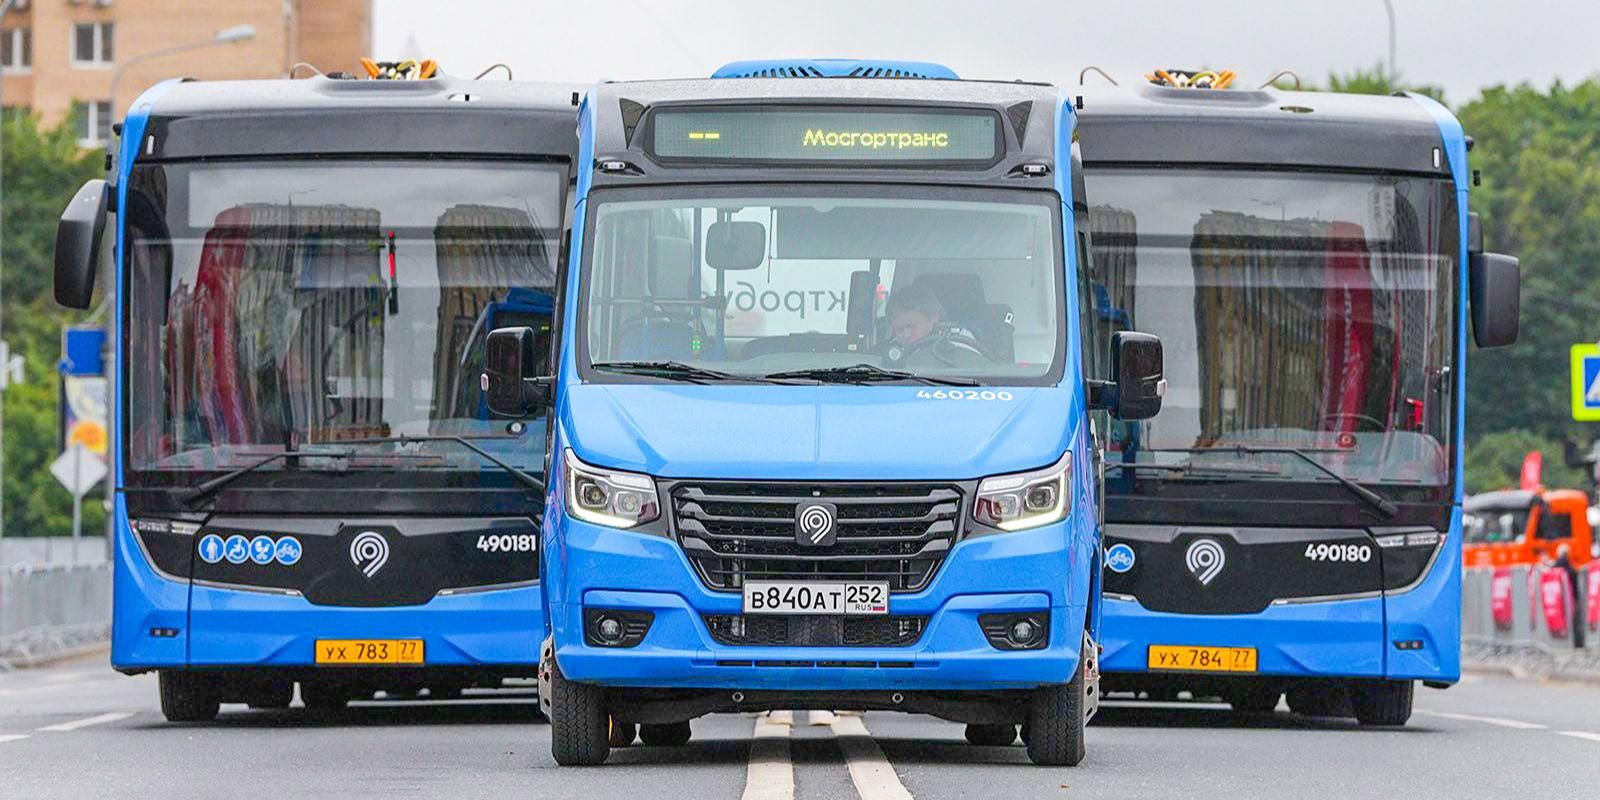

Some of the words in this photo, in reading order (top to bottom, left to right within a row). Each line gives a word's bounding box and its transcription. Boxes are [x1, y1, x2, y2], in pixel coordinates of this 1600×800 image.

[802, 128, 949, 149] Мосгортранс
[916, 390, 1013, 401] 460200
[476, 534, 536, 552] 490181
[1304, 543, 1372, 563] 490180
[847, 586, 882, 603] 252
[855, 603, 872, 611] RUS
[356, 643, 388, 660] 783
[400, 642, 417, 655] 77
[1189, 649, 1221, 667] 784
[1233, 650, 1250, 663] 77
